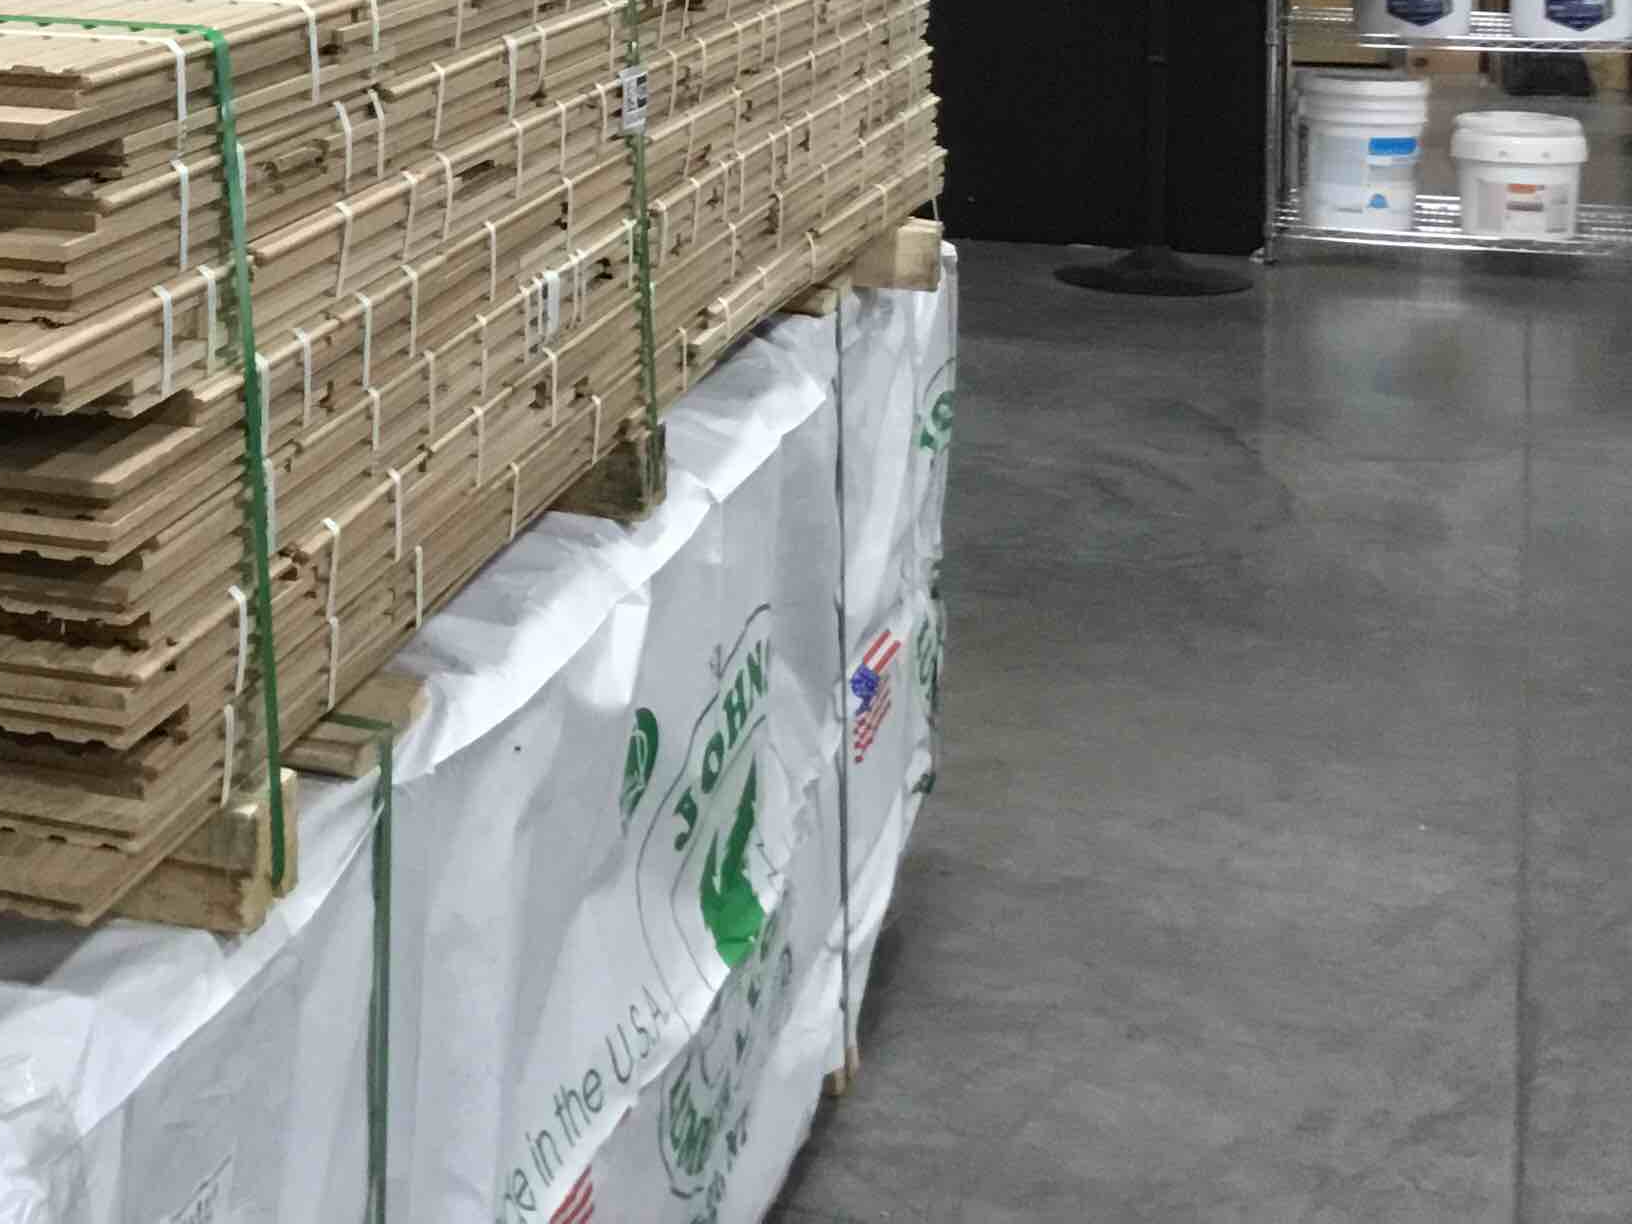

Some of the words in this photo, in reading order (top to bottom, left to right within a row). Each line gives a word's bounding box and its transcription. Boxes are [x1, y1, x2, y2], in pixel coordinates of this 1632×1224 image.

[672, 638, 770, 852] JOHN
[524, 1129, 564, 1188] in
[553, 1068, 605, 1149] the
